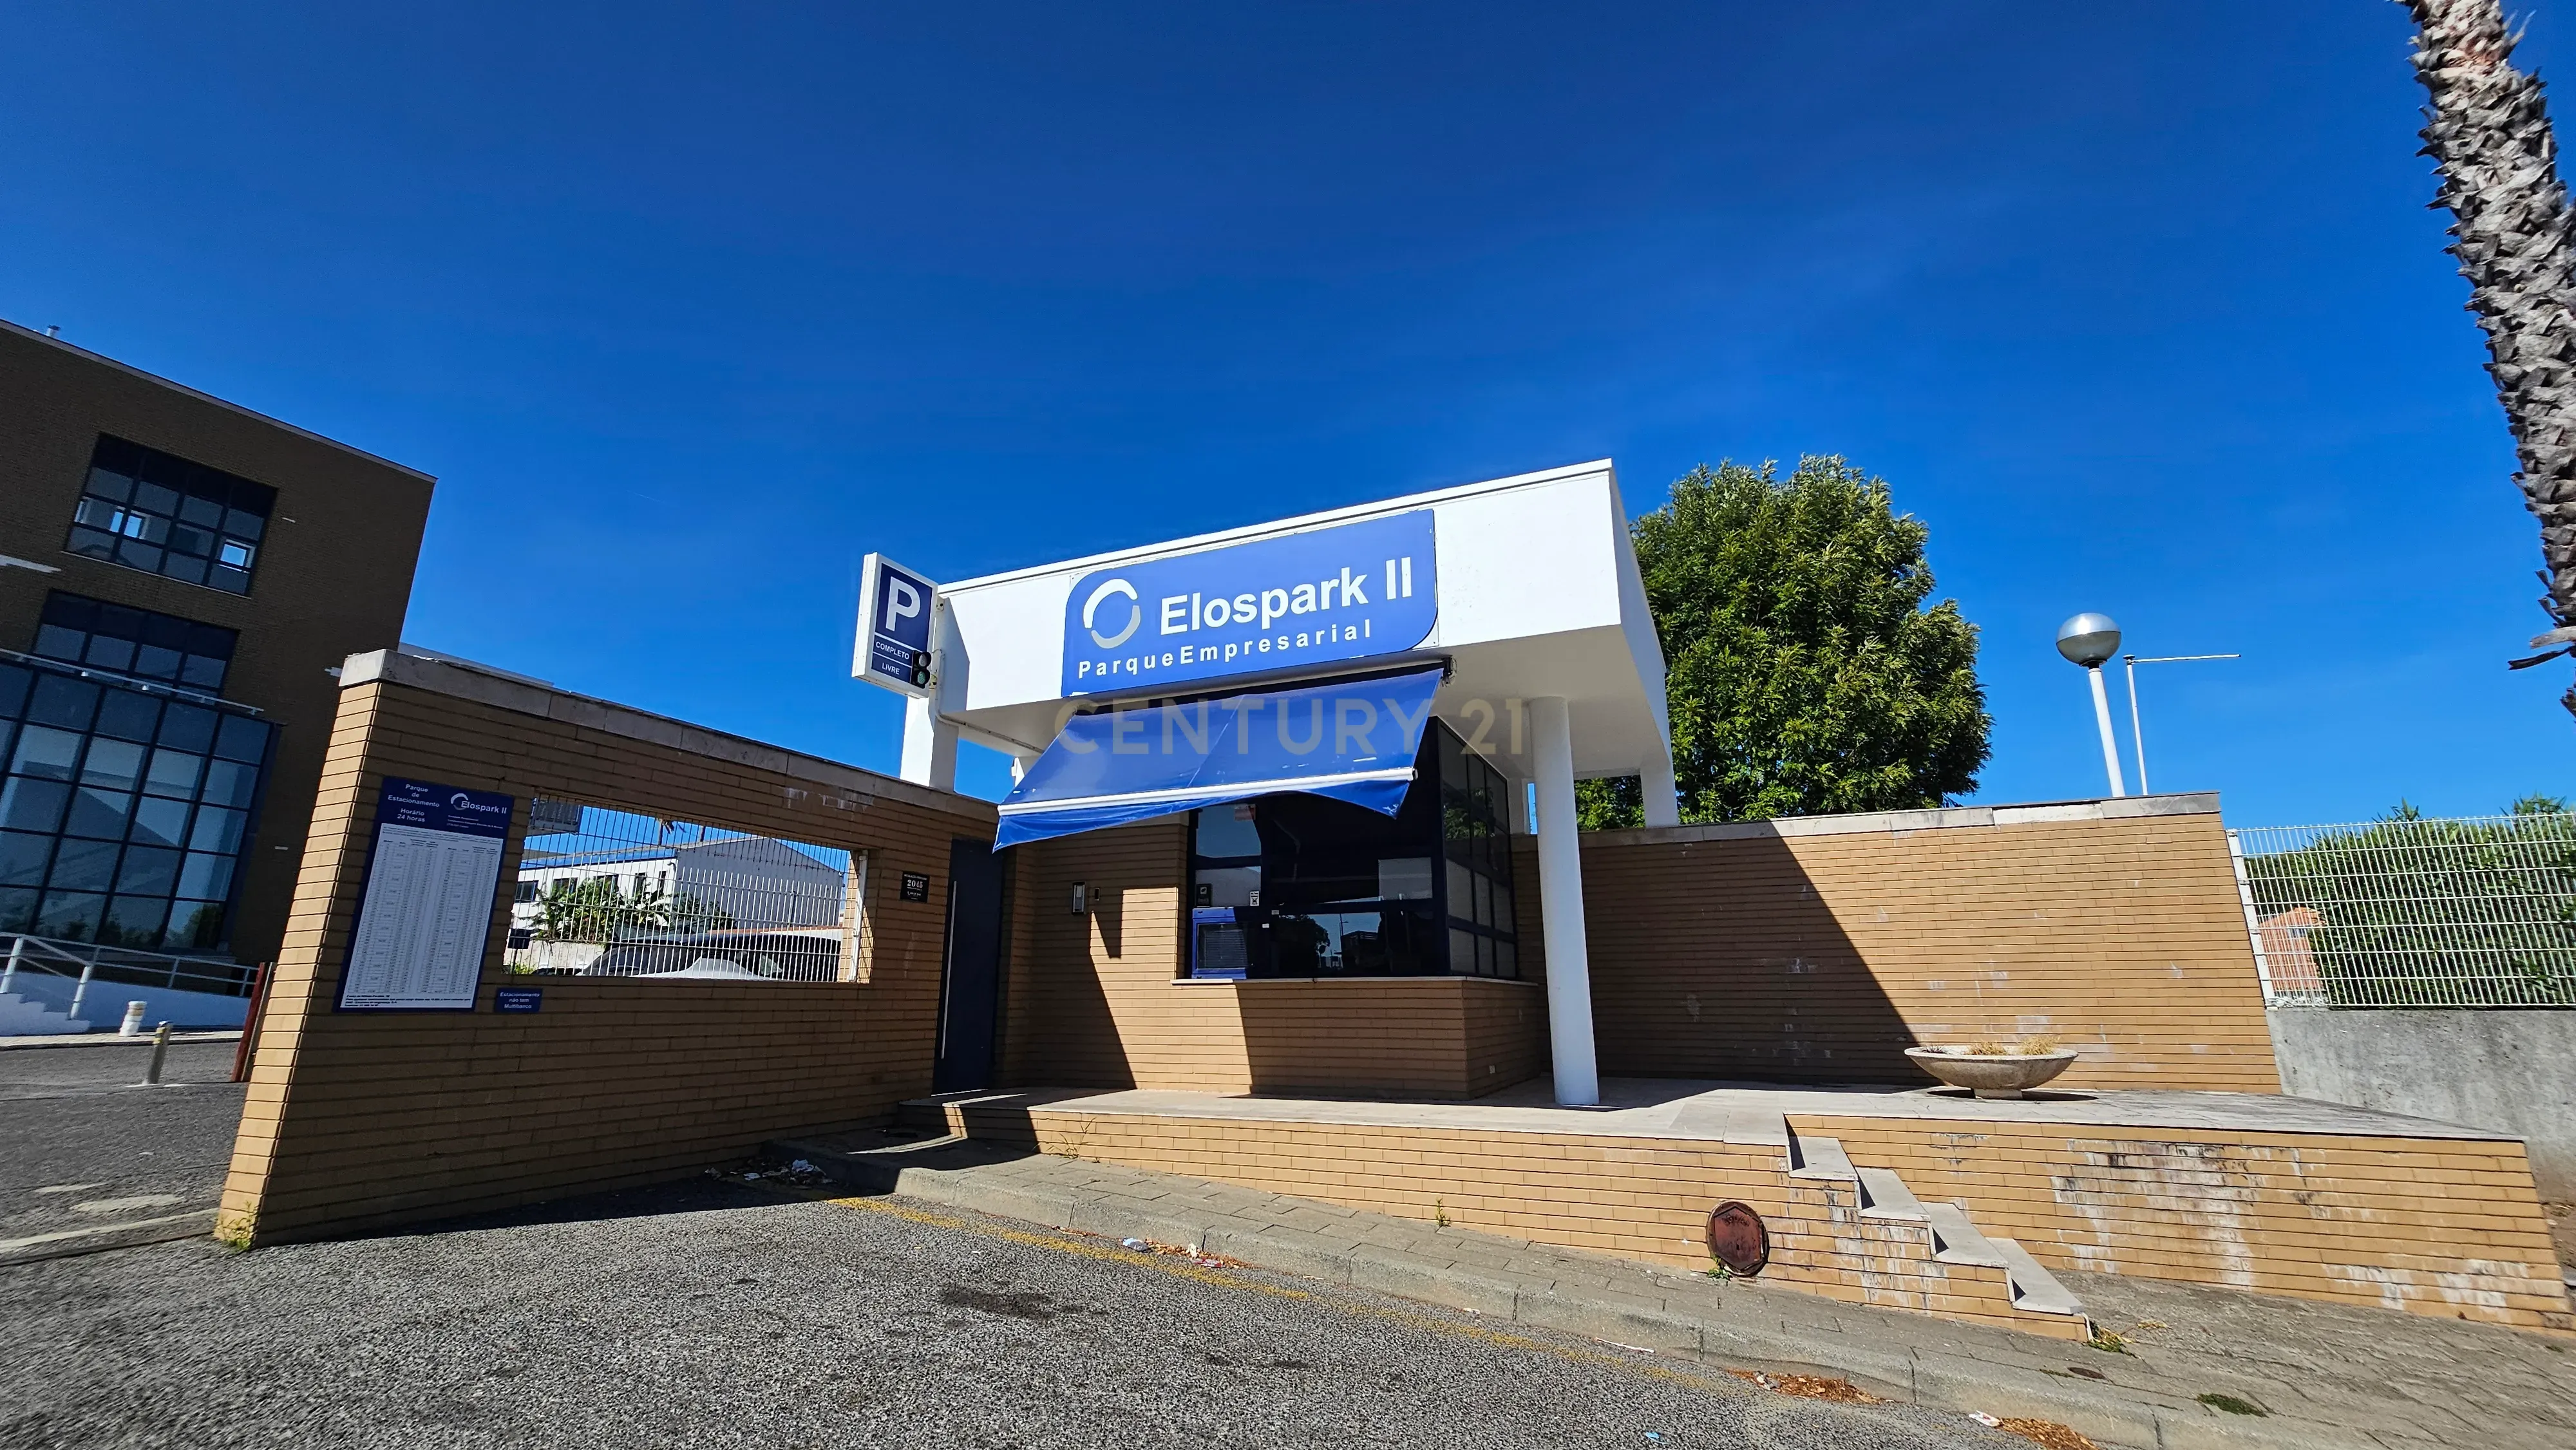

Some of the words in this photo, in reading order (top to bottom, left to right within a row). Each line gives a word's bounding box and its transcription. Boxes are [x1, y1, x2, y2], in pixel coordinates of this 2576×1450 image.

[1160, 567, 1368, 636] Elospark
[1385, 556, 1412, 600] II
[886, 576, 921, 632] P
[875, 641, 909, 660] COMPLETO
[882, 662, 900, 675] LIVRE
[405, 784, 428, 793] Parque
[388, 795, 440, 807] Estacionamento
[461, 800, 499, 813] Elospark
[401, 807, 424, 816] Horário
